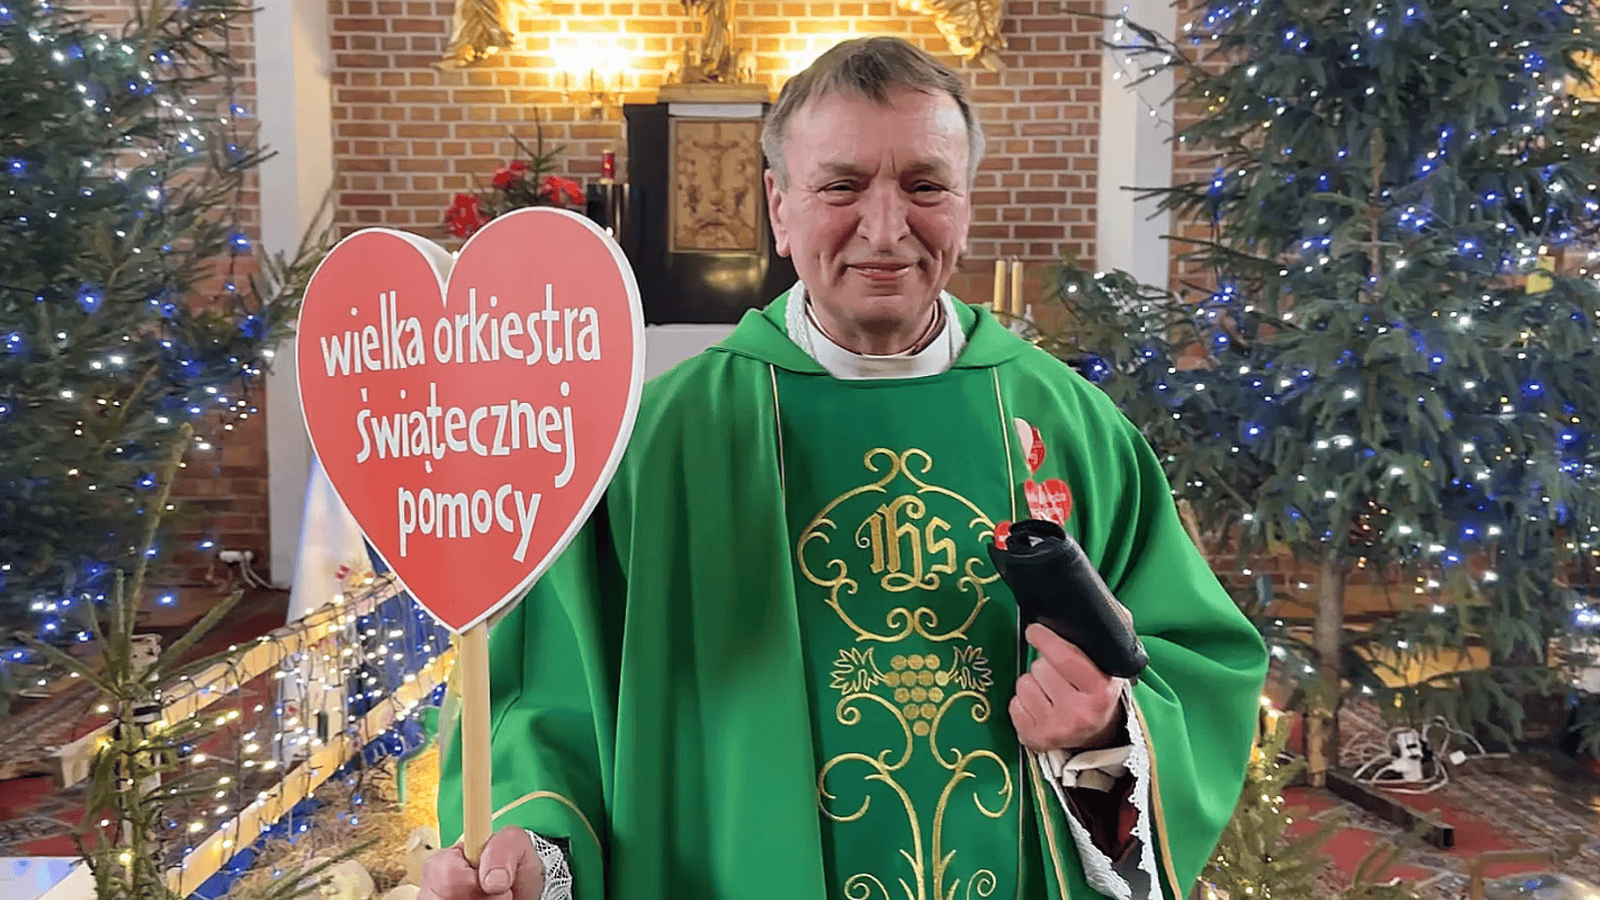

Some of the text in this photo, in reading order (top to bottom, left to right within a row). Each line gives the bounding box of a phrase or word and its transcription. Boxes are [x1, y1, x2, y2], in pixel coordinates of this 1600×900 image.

[320, 283, 601, 377] wielka orkiestra
[356, 381, 576, 489] świątecznej
[398, 483, 542, 563] pomocy
